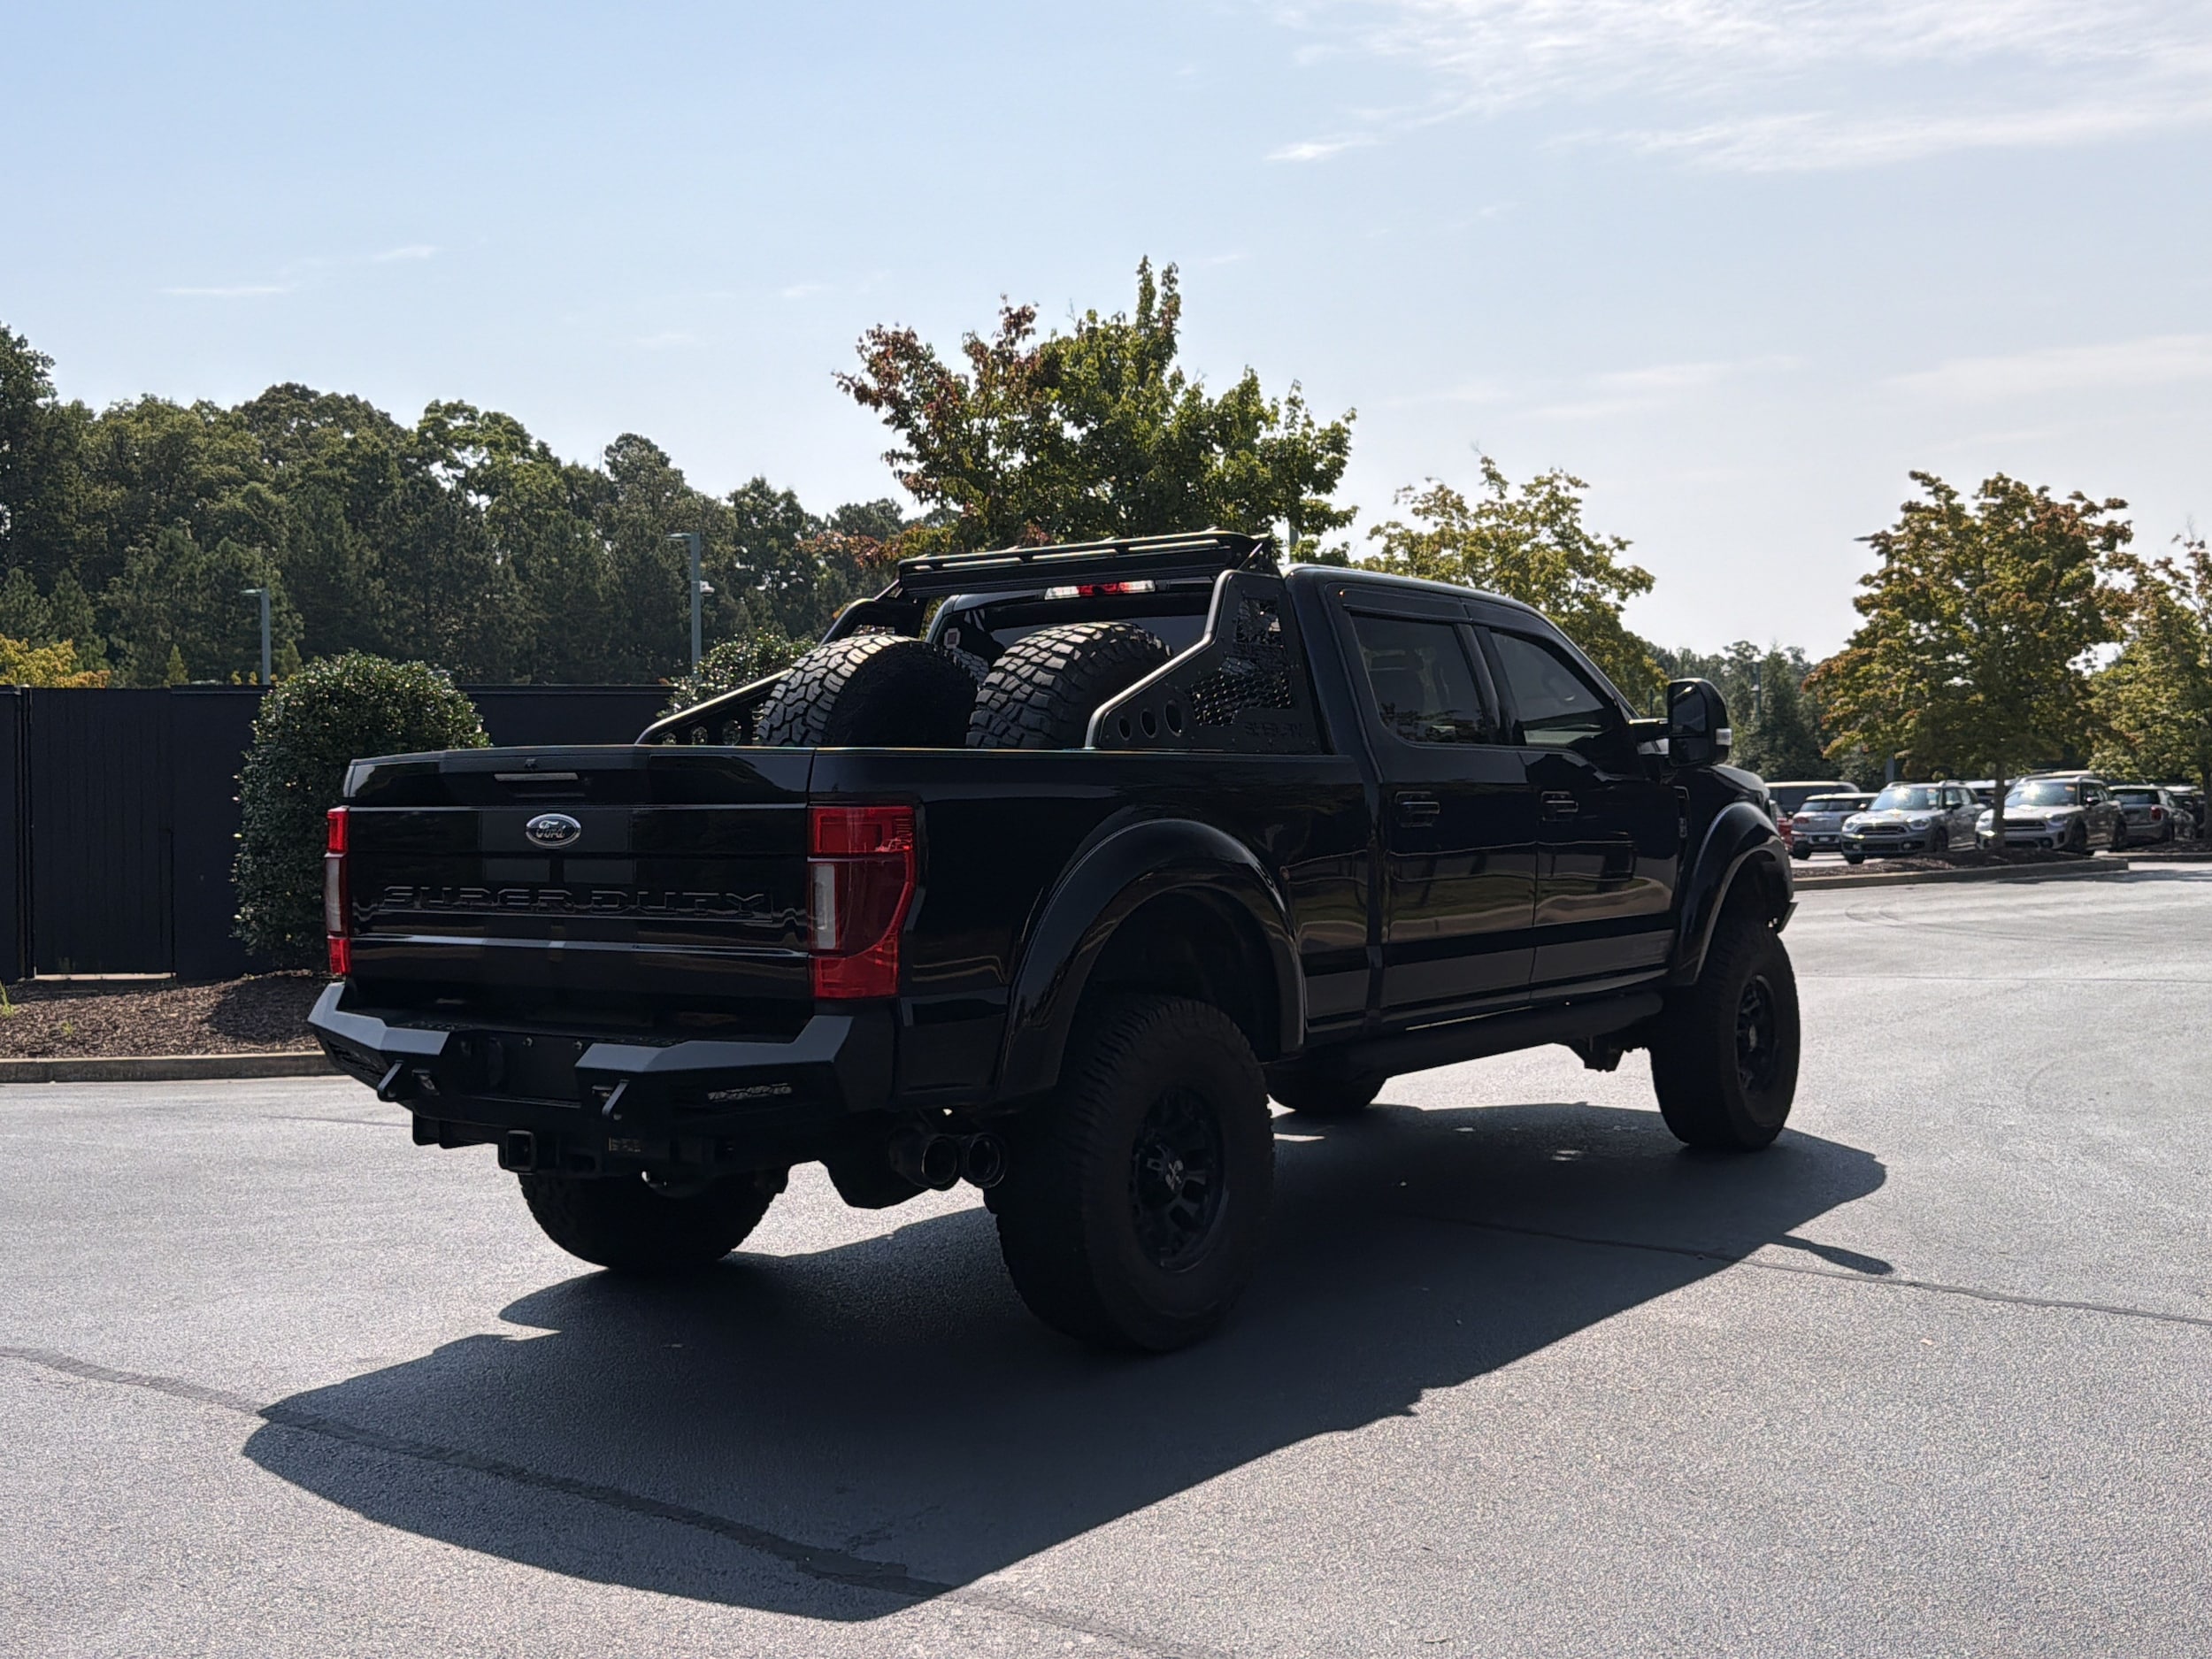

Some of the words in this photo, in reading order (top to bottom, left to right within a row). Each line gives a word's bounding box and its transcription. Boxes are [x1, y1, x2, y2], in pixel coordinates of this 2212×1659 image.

[535, 820, 566, 840] Ford
[382, 885, 573, 913] SUPER
[589, 889, 764, 916] DUTY
